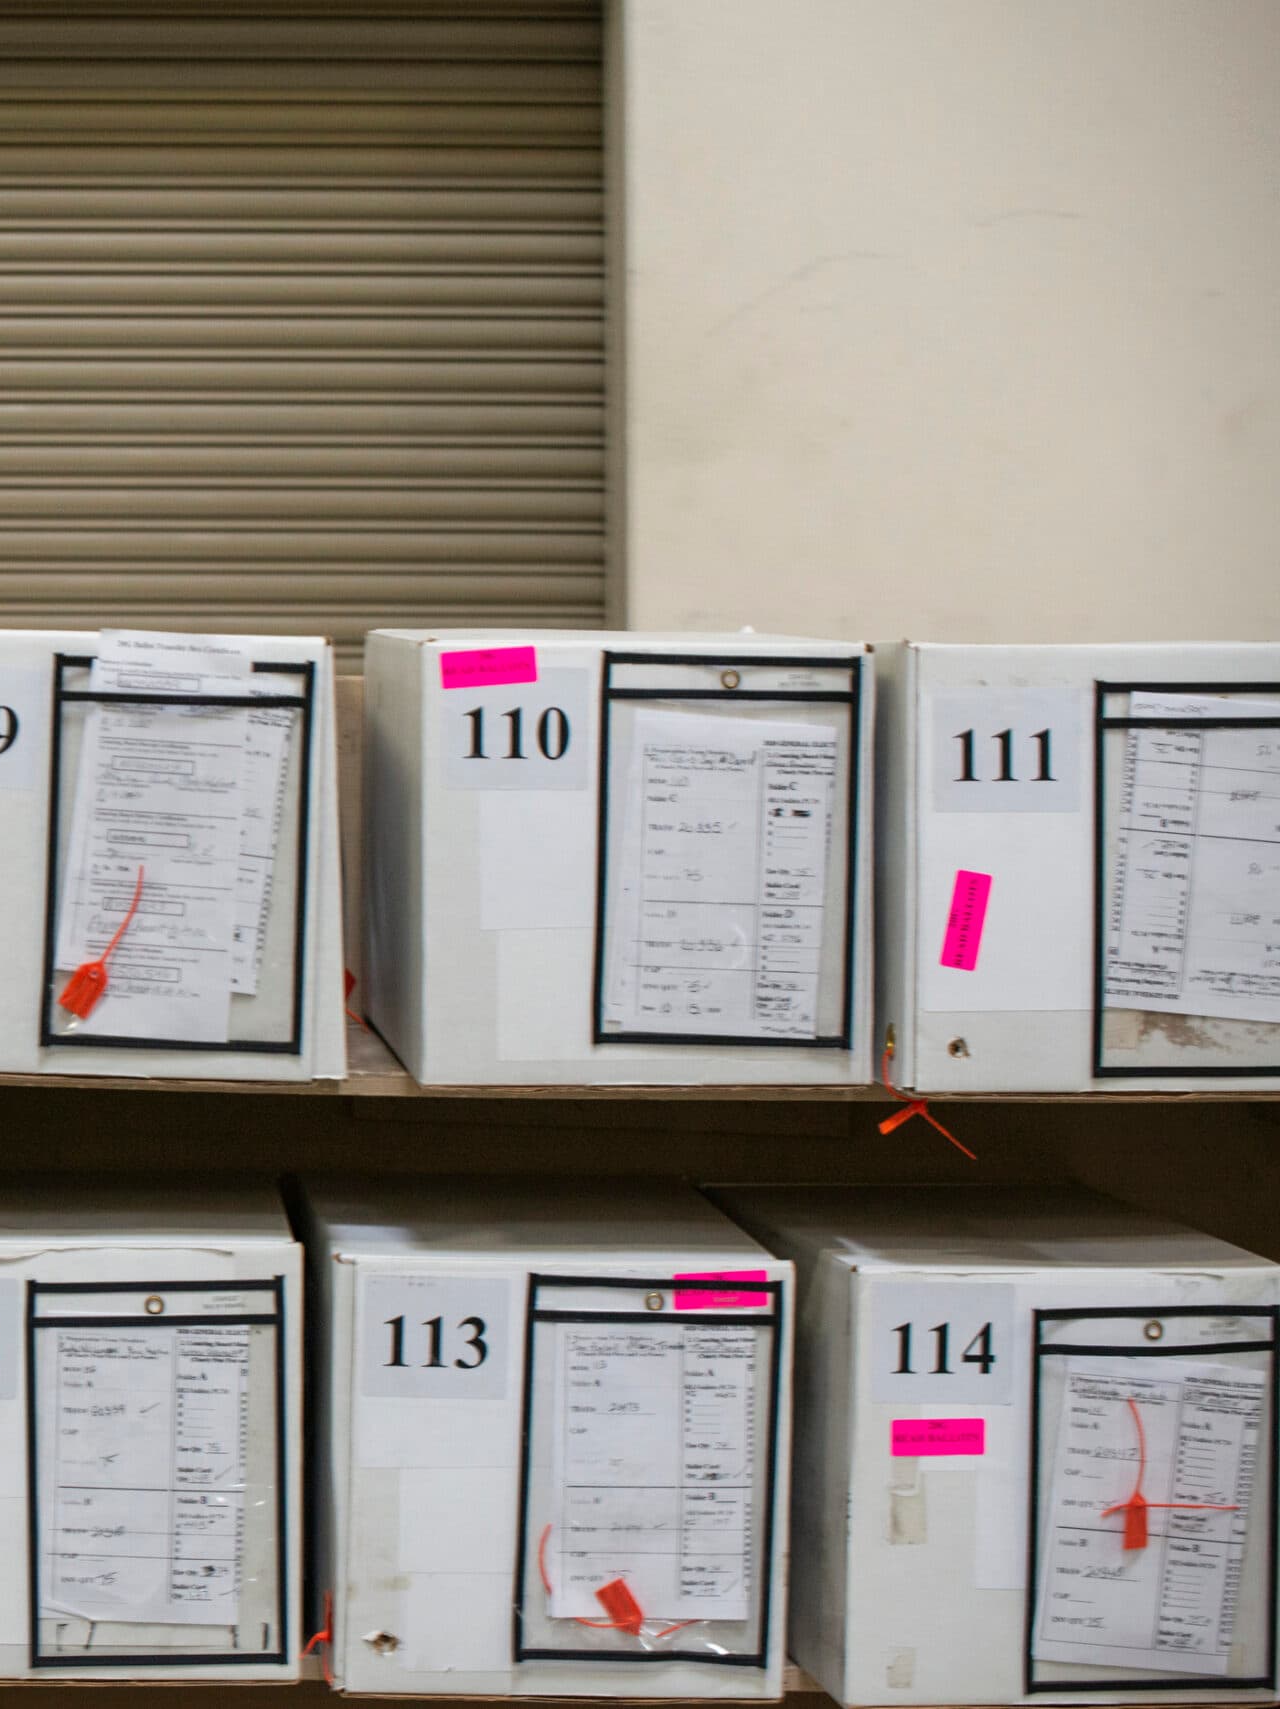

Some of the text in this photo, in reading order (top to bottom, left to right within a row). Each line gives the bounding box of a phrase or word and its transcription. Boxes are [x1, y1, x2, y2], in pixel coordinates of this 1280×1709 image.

[465, 707, 570, 760] 110
[953, 728, 1057, 782] 111
[383, 1315, 488, 1370] 113
[891, 1322, 996, 1375] 114
